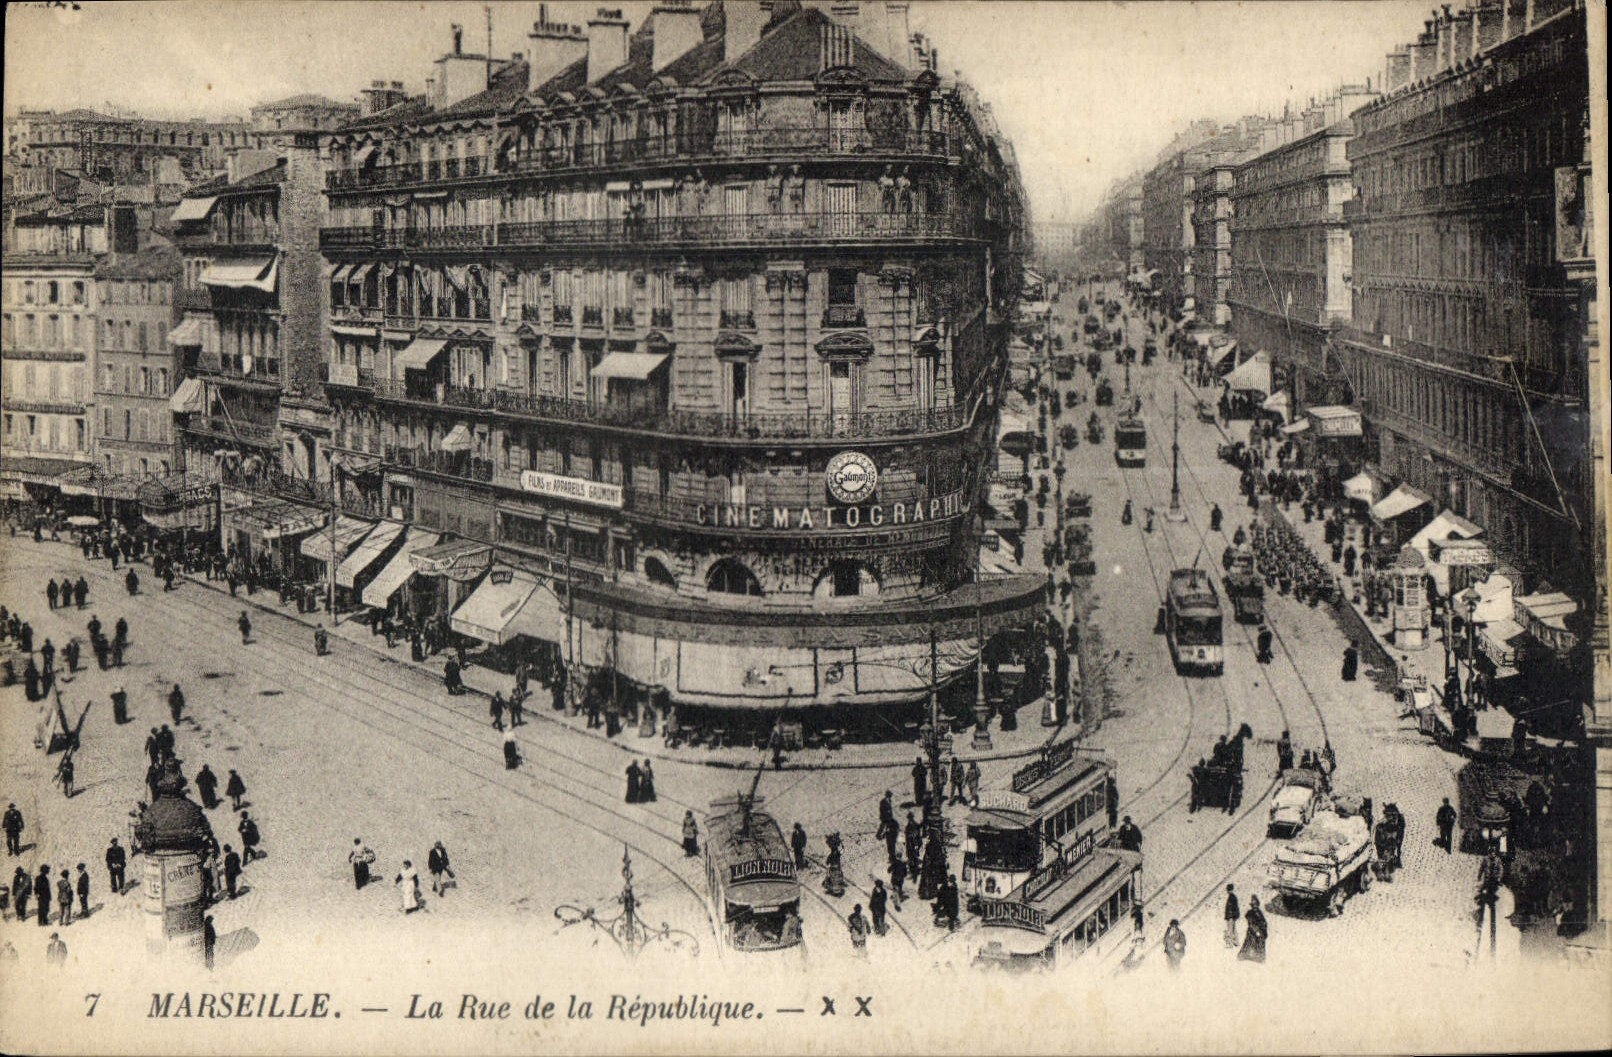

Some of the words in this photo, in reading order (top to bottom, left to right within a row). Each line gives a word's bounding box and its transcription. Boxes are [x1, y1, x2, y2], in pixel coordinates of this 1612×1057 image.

[834, 471, 871, 484] Gaumont
[552, 478, 586, 498] APPAREILS
[588, 484, 620, 503] GAUMONT
[1066, 836, 1092, 865] MENIER
